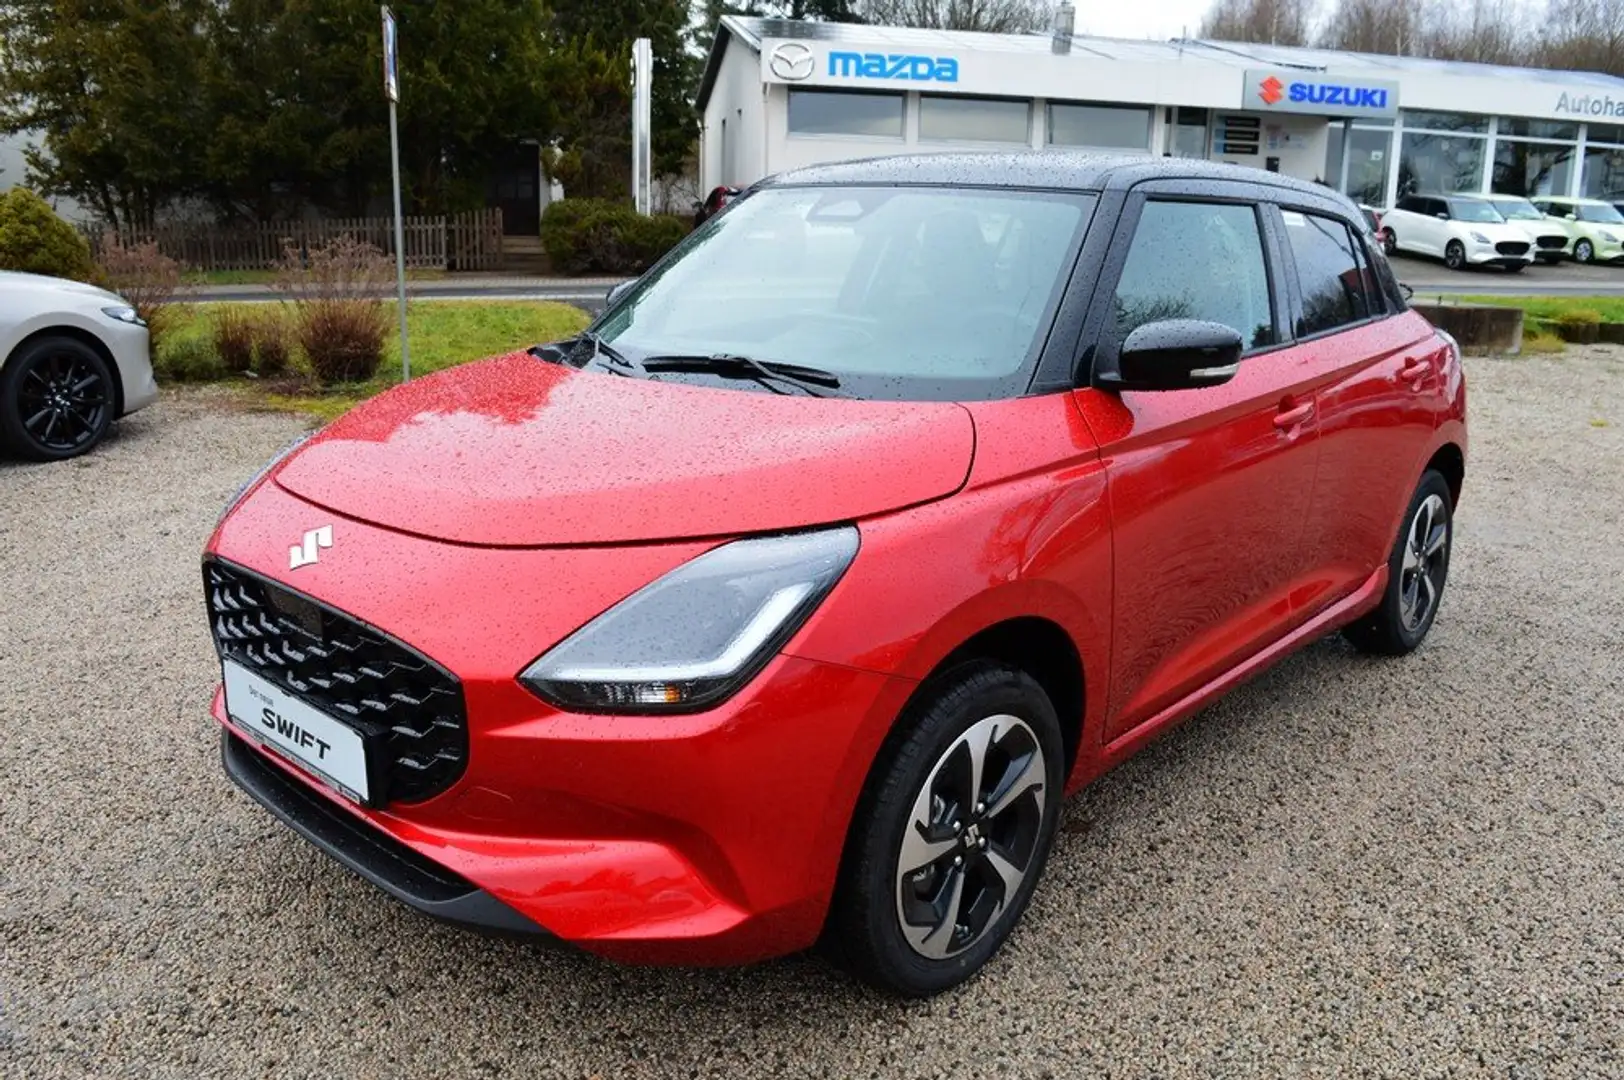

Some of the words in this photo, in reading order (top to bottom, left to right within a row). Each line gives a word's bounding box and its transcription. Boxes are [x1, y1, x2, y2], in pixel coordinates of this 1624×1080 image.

[1288, 82, 1387, 108] SUZUKI
[1555, 91, 1624, 116] Autoha
[261, 707, 331, 760] SWIFT
